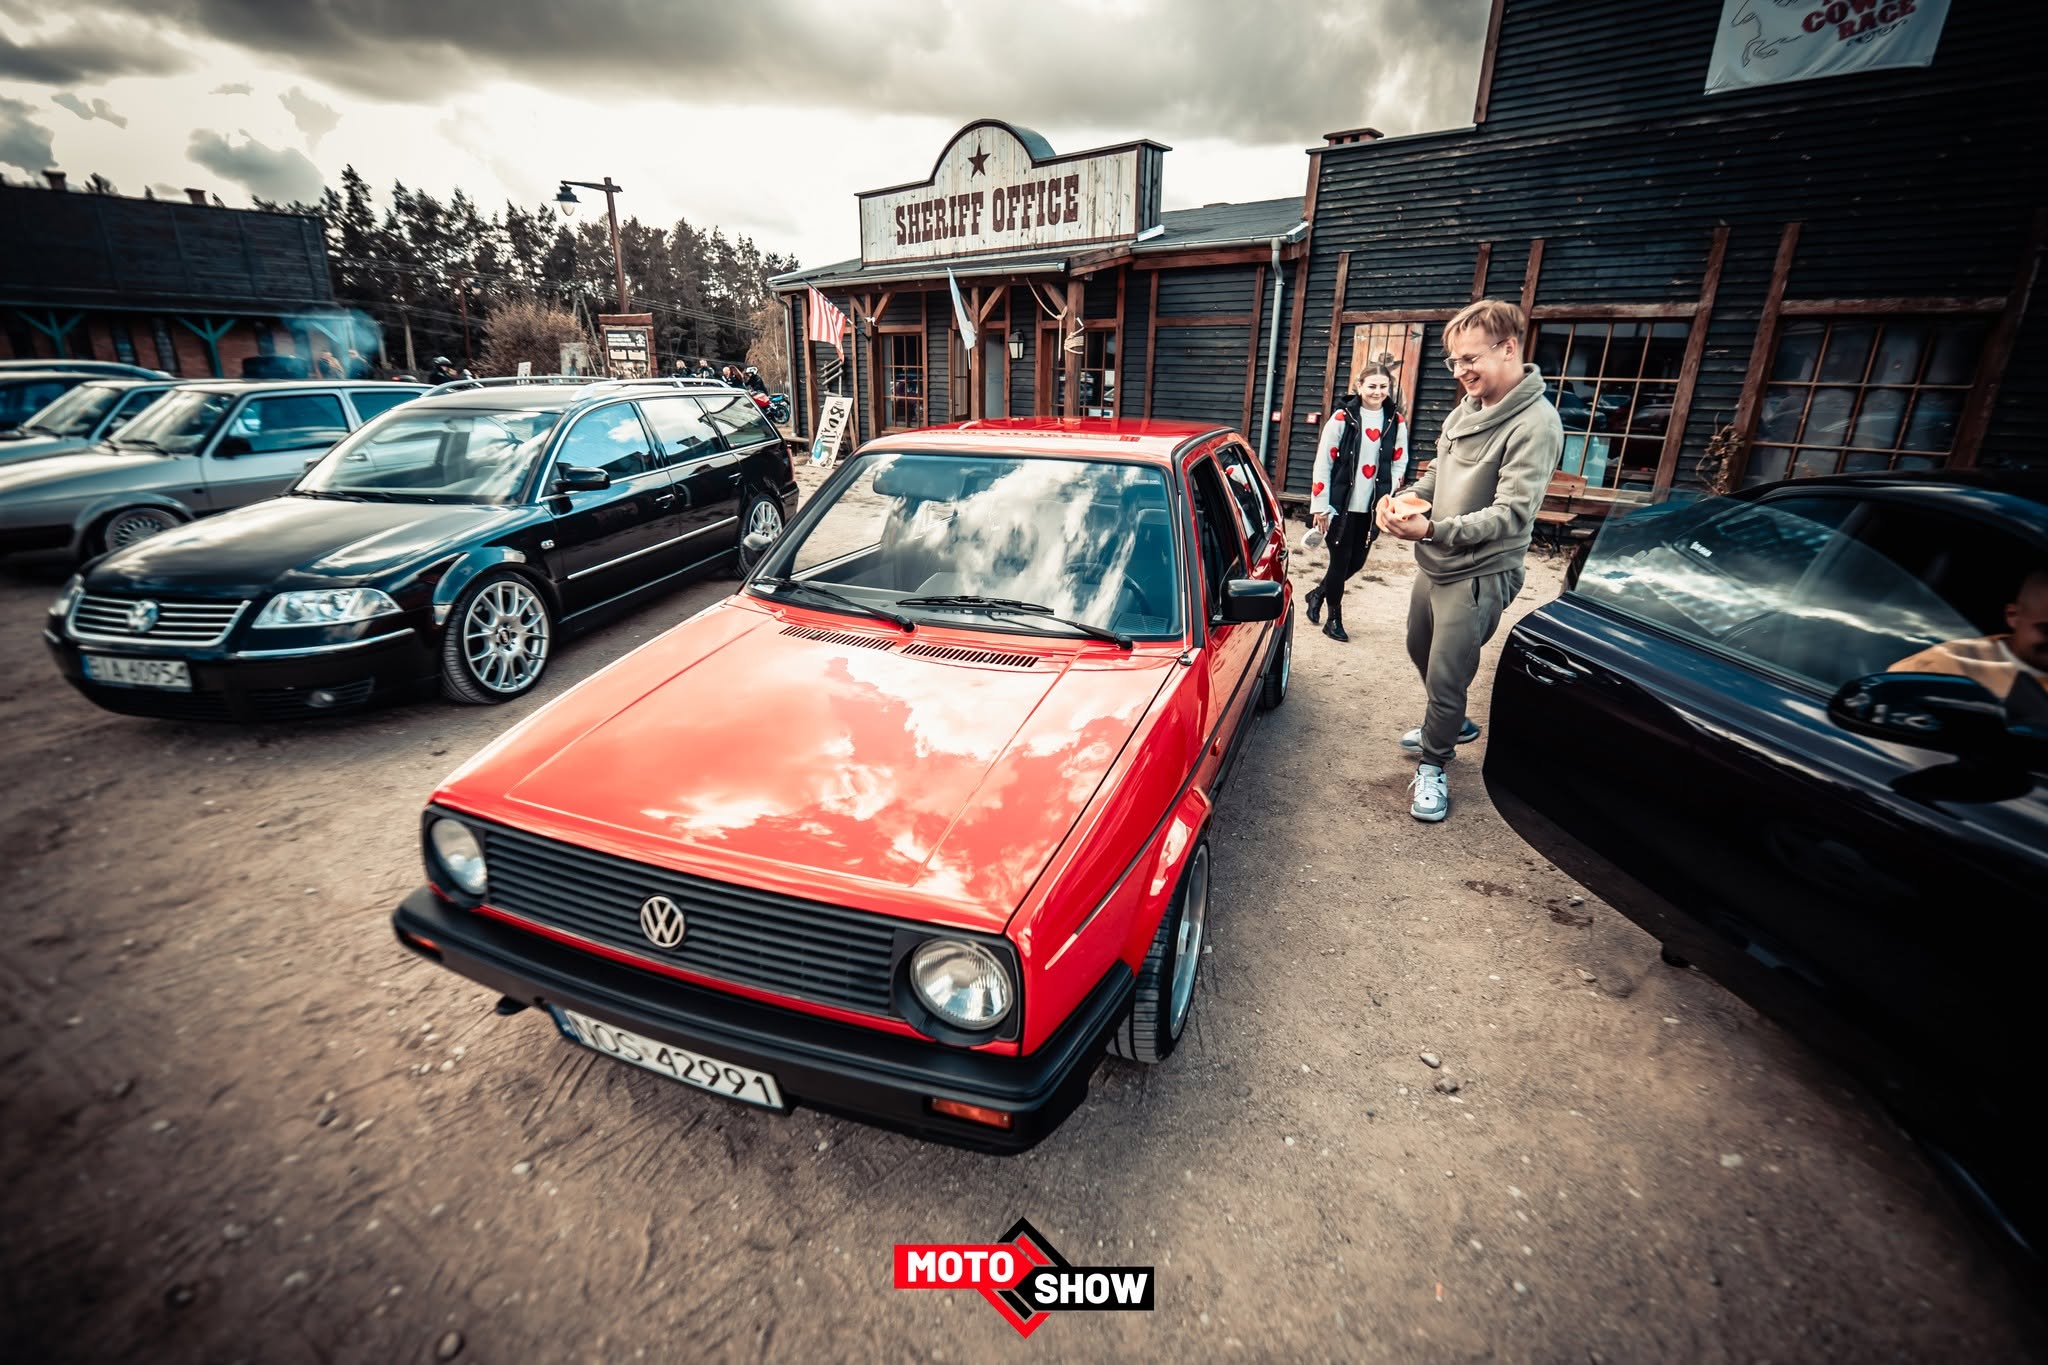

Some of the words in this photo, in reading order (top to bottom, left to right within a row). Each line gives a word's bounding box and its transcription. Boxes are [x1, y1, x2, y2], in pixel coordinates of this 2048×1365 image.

[1837, 0, 1917, 41] RACE
[895, 191, 984, 246] SHERIFF
[992, 174, 1080, 233] OFFICE
[567, 1012, 644, 1062] NOS
[656, 1047, 773, 1105] 42991
